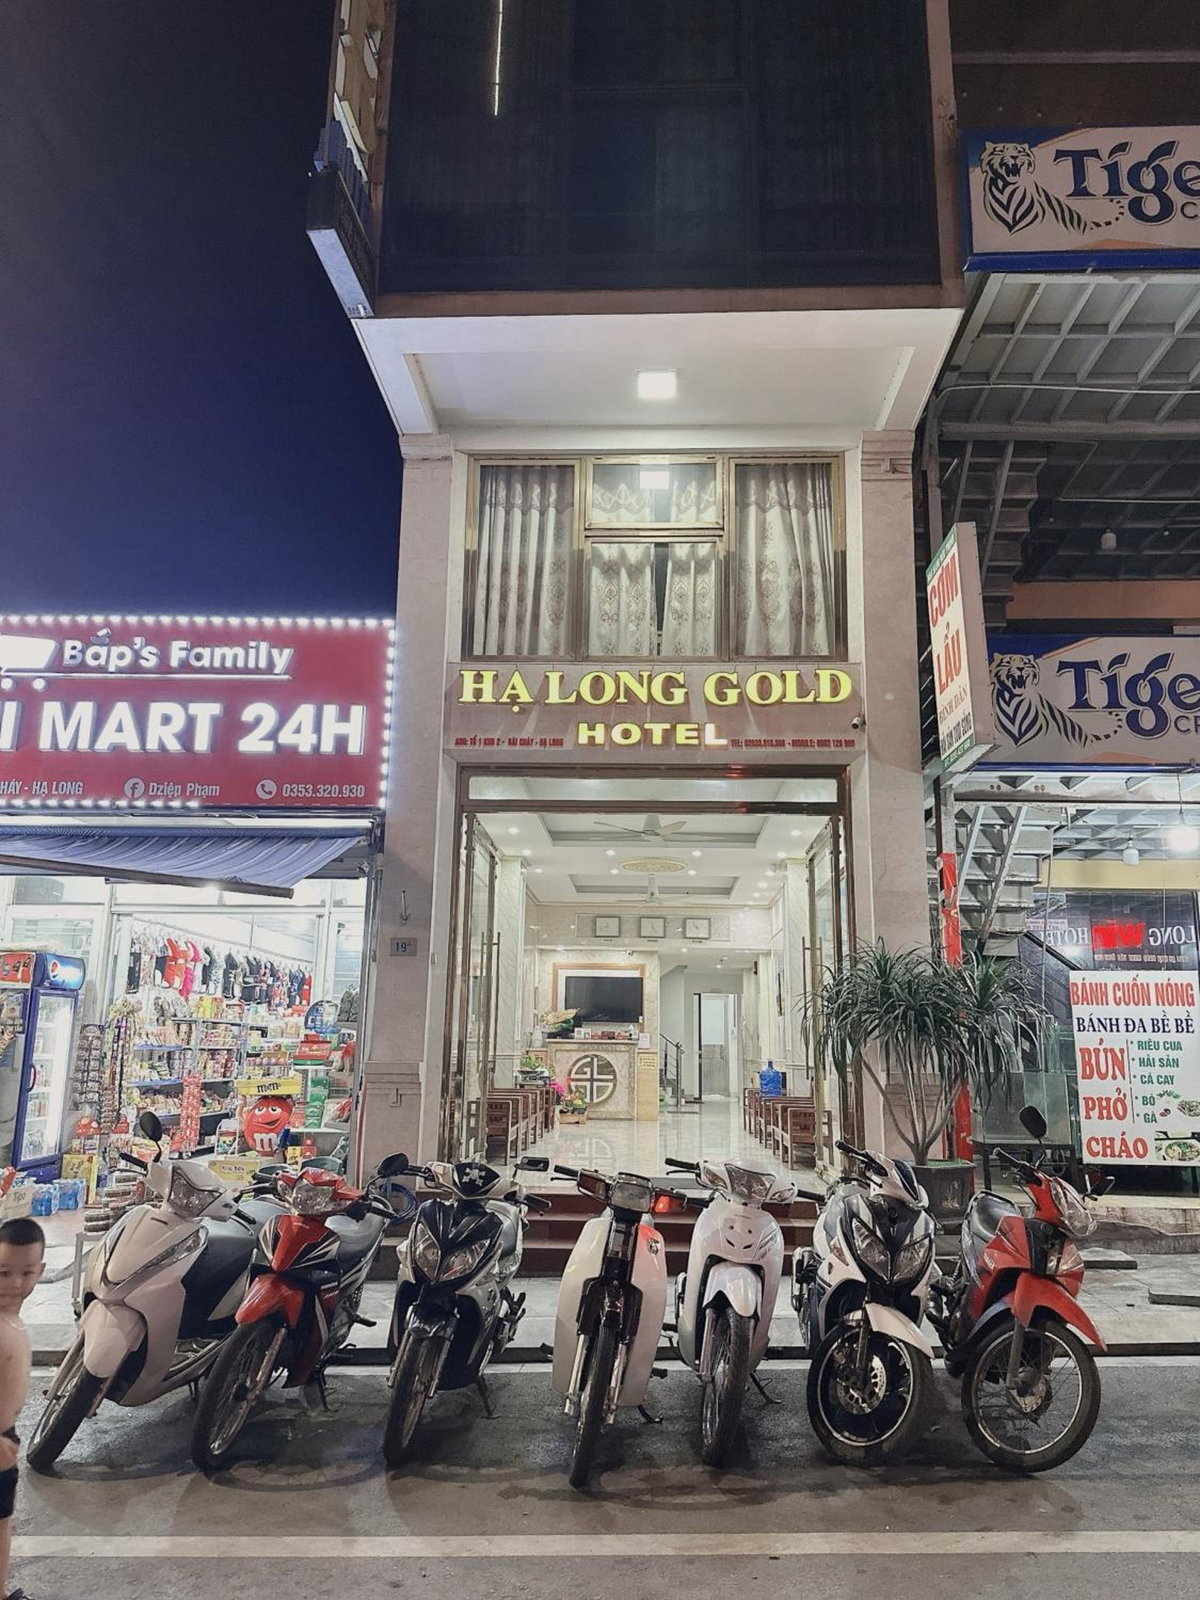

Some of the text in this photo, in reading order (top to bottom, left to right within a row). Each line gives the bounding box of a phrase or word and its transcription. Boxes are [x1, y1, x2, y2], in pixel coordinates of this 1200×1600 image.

[929, 552, 959, 628] CƠM
[169, 639, 294, 675] Family
[458, 668, 852, 714] HẠ LONG GOLD
[38, 700, 222, 752] MART
[237, 701, 367, 754] 24H
[577, 722, 728, 746] HOTEL
[32, 781, 48, 797] HẠ
[52, 781, 83, 795] LONG
[282, 784, 365, 798] 0353.320.930
[1071, 974, 1196, 1008] BÁNH CUỐN NÓNG
[1076, 1013, 1121, 1034] BÁNH
[1124, 1017, 1148, 1034] ĐA
[1163, 1040, 1183, 1052] CUA
[1156, 1074, 1175, 1086] CAY
[1082, 1086, 1128, 1121] PHỞ
[1086, 1131, 1149, 1160] CHÁO
